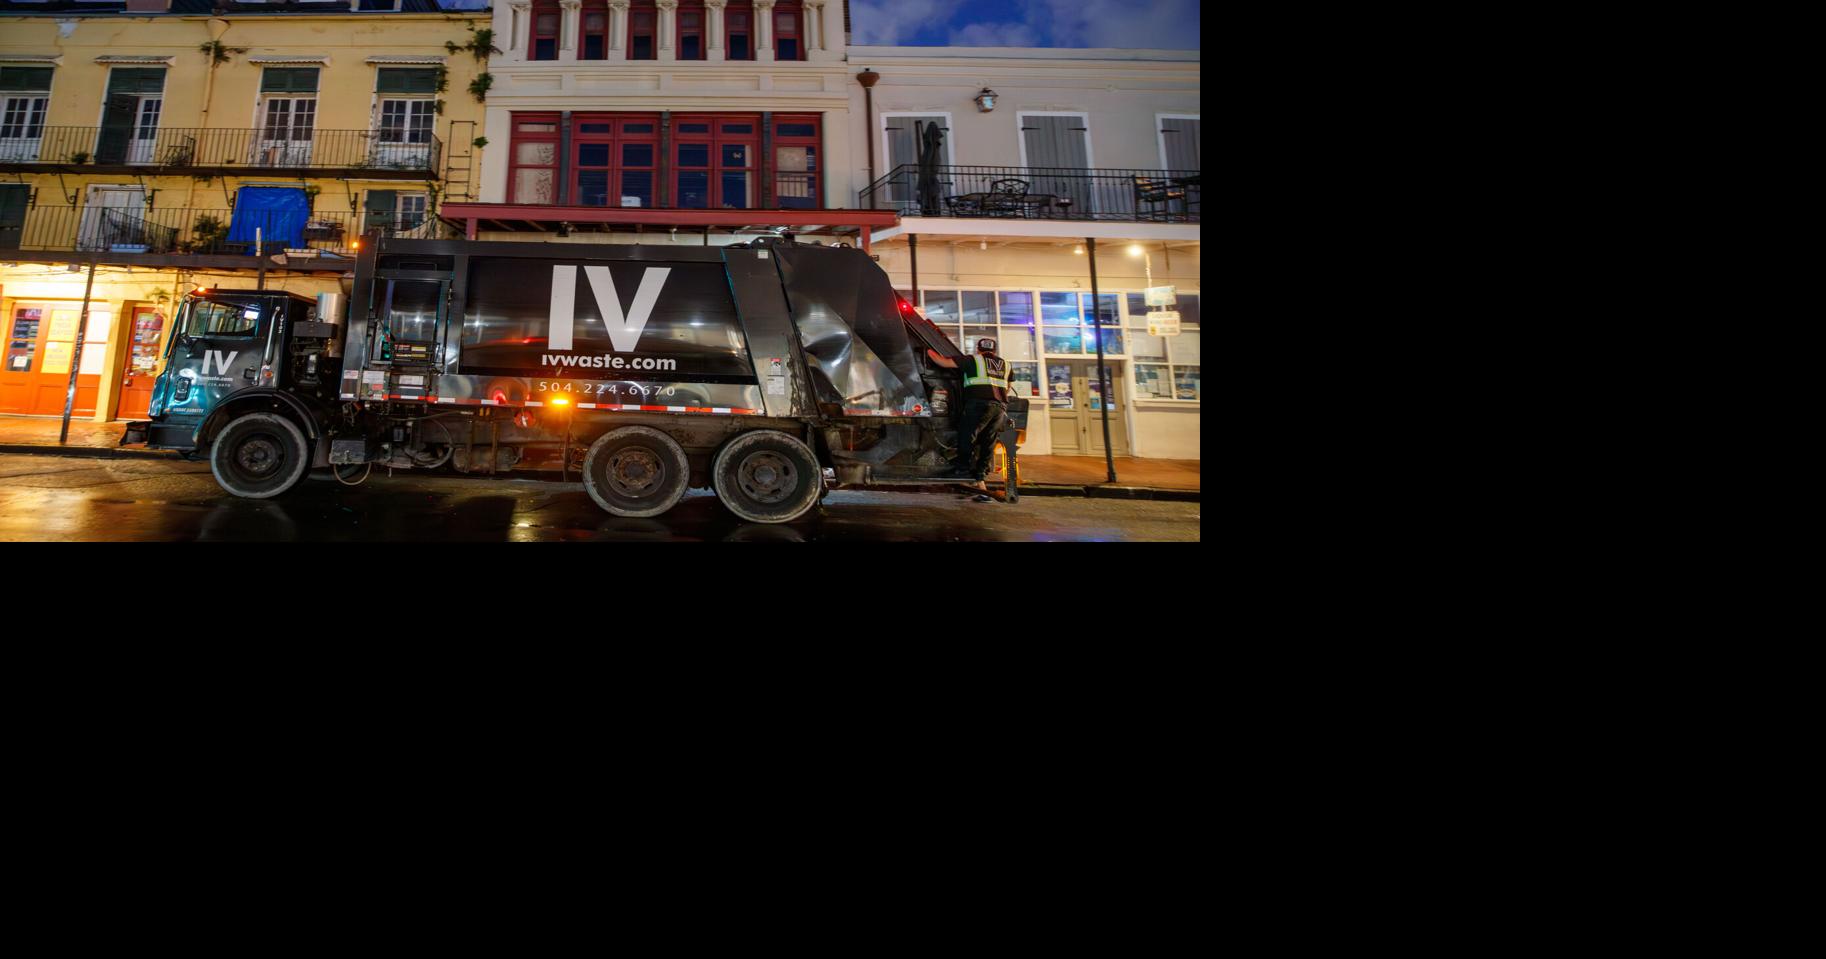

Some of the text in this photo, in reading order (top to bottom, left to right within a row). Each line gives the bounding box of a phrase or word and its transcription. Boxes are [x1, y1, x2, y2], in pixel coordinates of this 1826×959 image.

[548, 265, 672, 352] IV
[201, 350, 239, 375] IV
[542, 354, 677, 371] ivwaste.com
[539, 381, 676, 397] 504.224.6670
